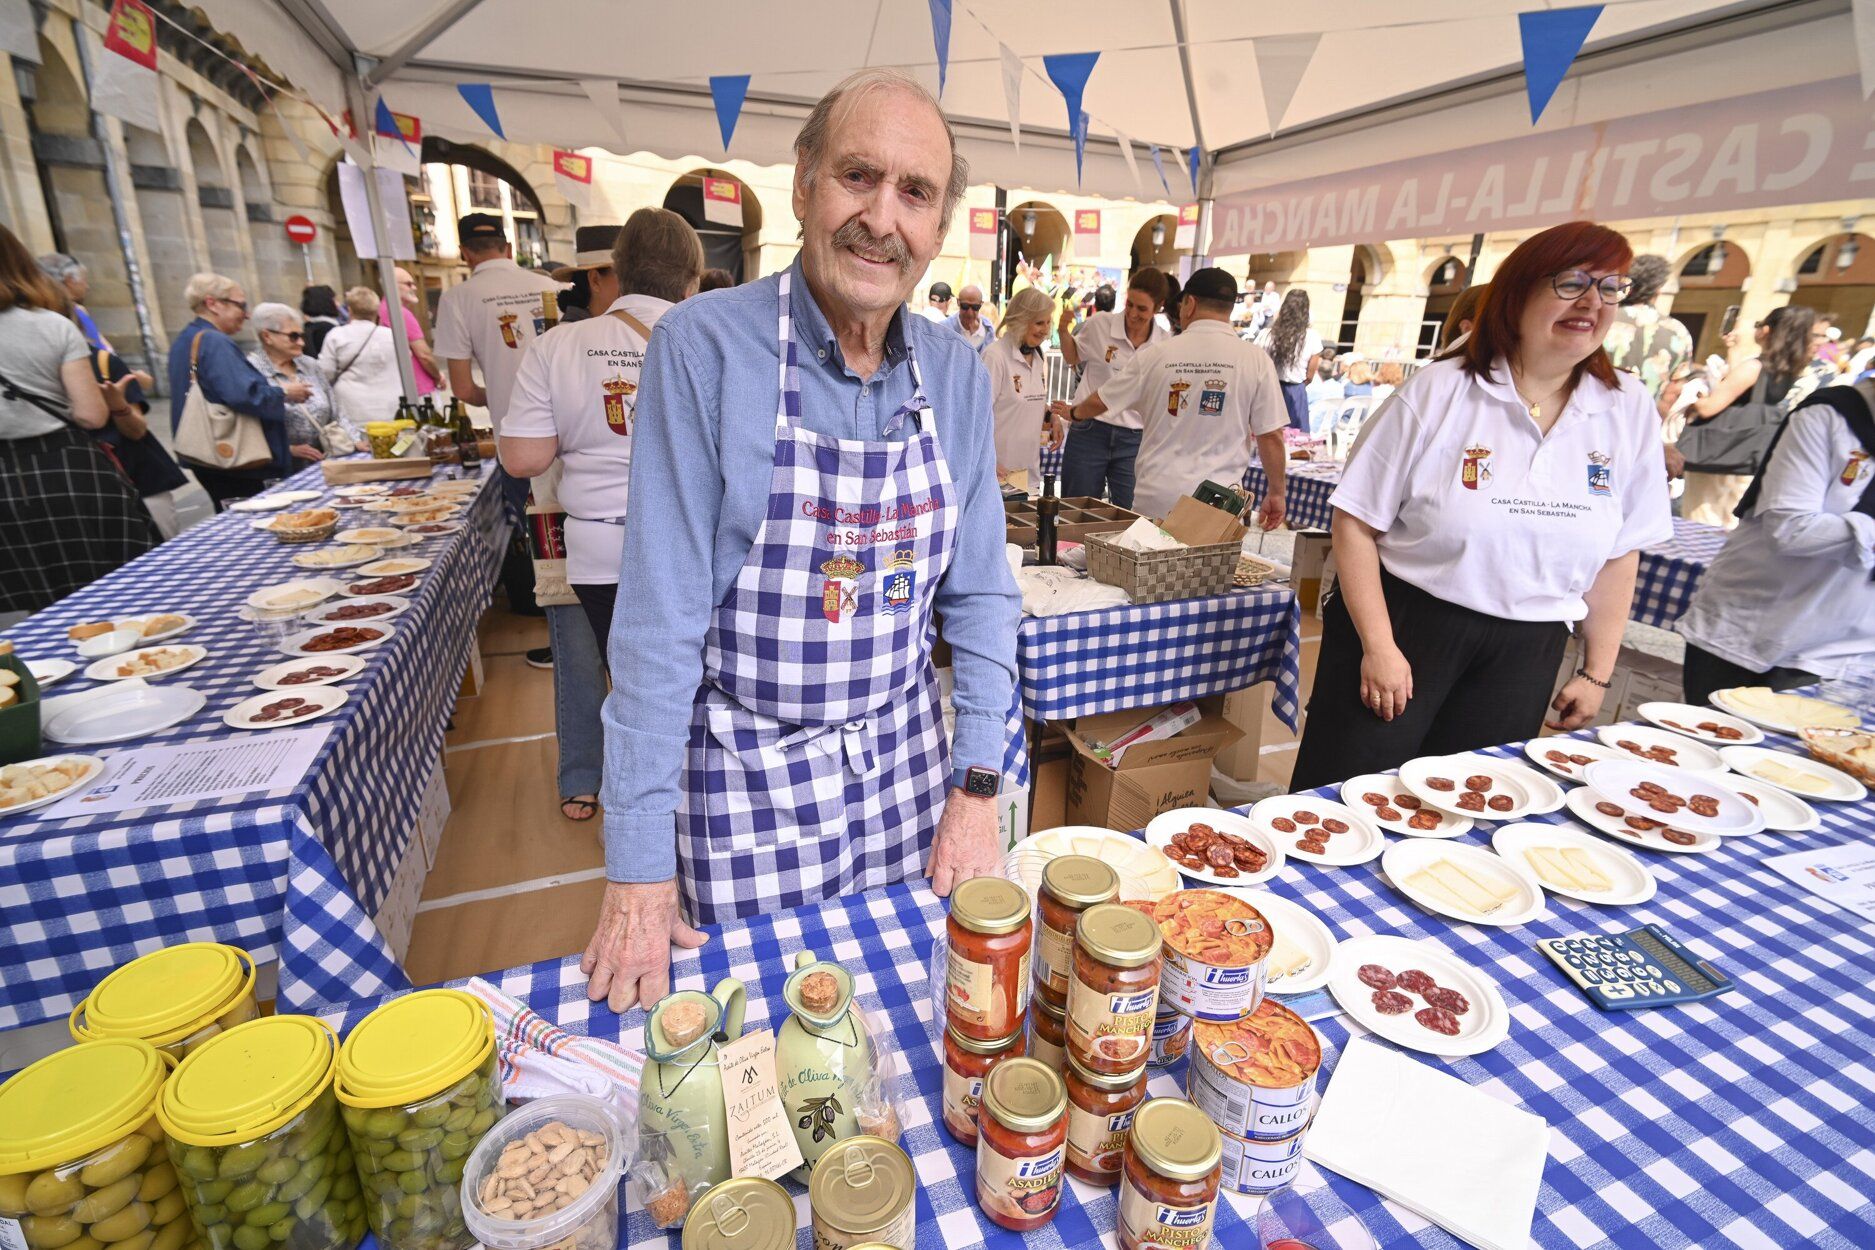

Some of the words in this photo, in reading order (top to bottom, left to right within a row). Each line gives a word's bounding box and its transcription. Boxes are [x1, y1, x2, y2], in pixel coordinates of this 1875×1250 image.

[587, 349, 610, 357] CASA
[620, 360, 638, 368] SAN
[1513, 498, 1546, 507] CASTILLA
[1562, 502, 1592, 512] MANCHA
[827, 533, 842, 545] en
[845, 531, 867, 545] San
[869, 523, 919, 544] Sebastián
[1114, 1011, 1151, 1026] PISTO
[798, 1067, 830, 1085] Oliva
[1259, 1107, 1307, 1125] CALLOS
[1251, 1160, 1298, 1180] CALLOS
[1146, 1228, 1208, 1248] MANCHEGO
[1161, 1226, 1201, 1239] PISTO
